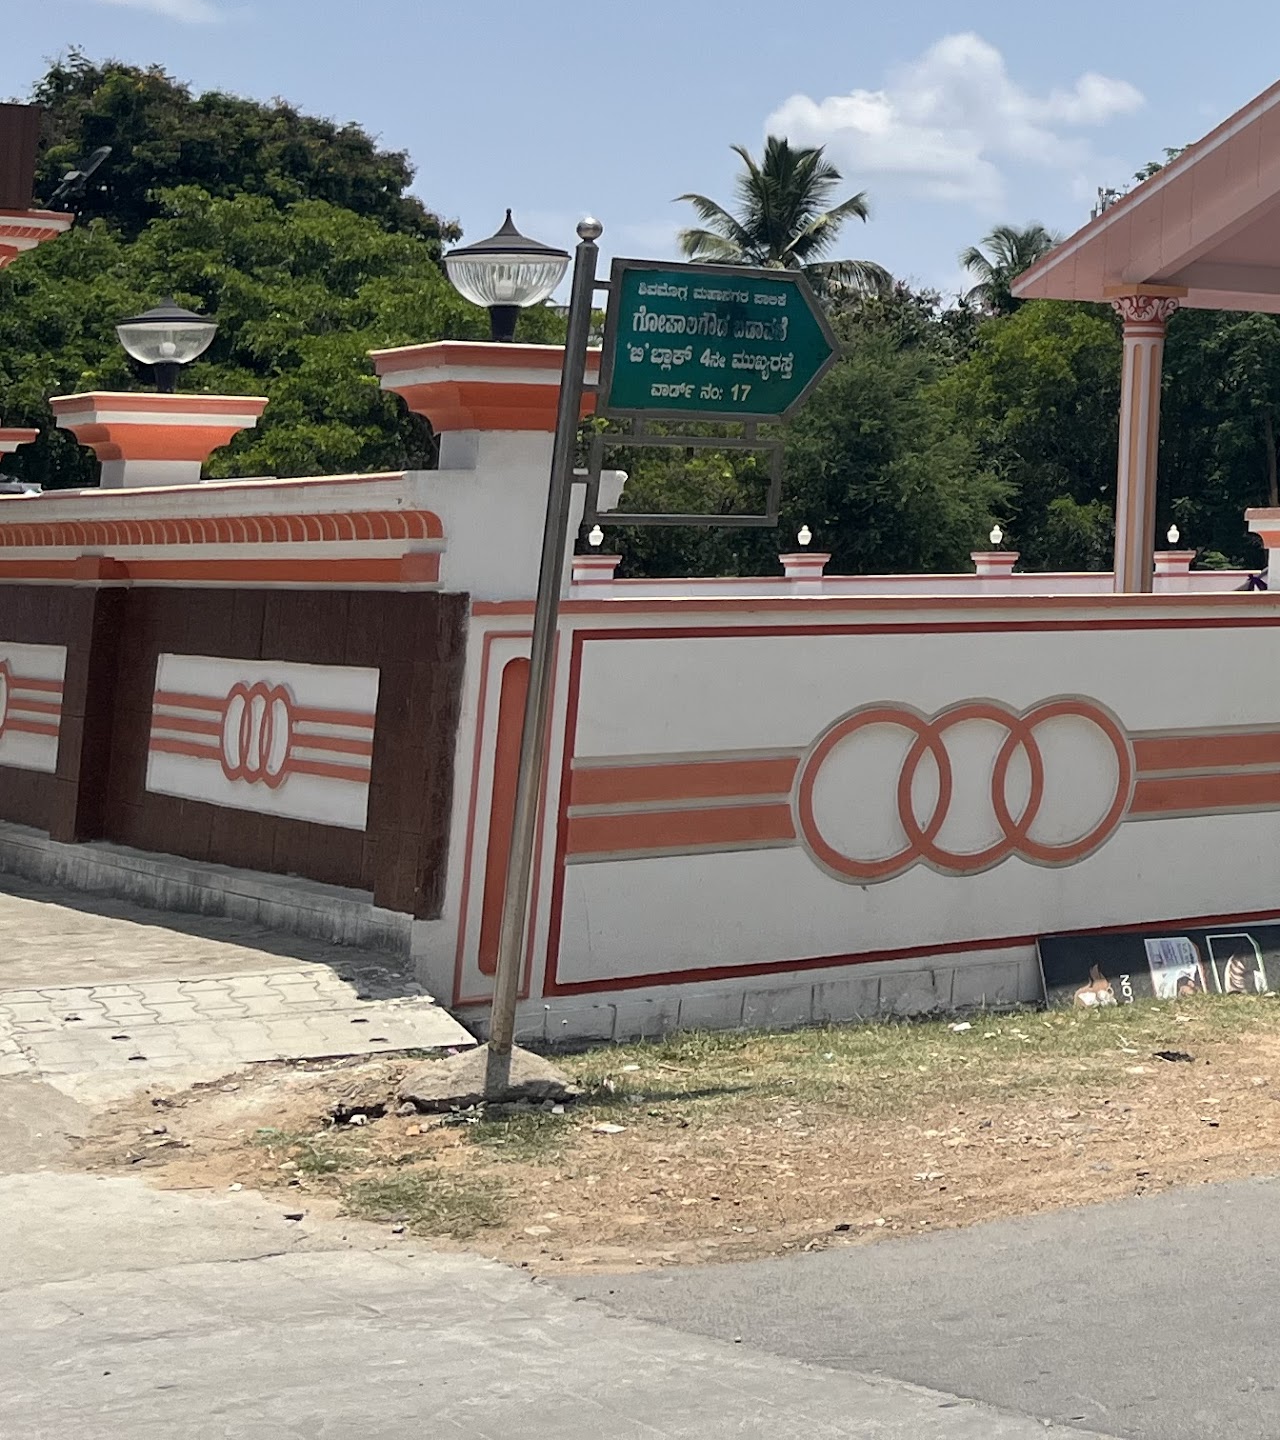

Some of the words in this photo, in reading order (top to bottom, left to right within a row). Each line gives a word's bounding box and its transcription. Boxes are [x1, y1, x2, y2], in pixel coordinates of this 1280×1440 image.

[638, 282, 688, 301] ಶಿವಮೊಗ್ಗ
[693, 287, 749, 303] ಮಹಾನಗರ
[650, 345, 693, 372] ಬ್ಲಾಕ್
[700, 348, 726, 369] 4ನೇ
[731, 349, 795, 381] ಮುಖ್ಯರಸ್ತೆ
[650, 382, 696, 398] ವಾರ್ಡ್
[730, 383, 752, 402] 17
